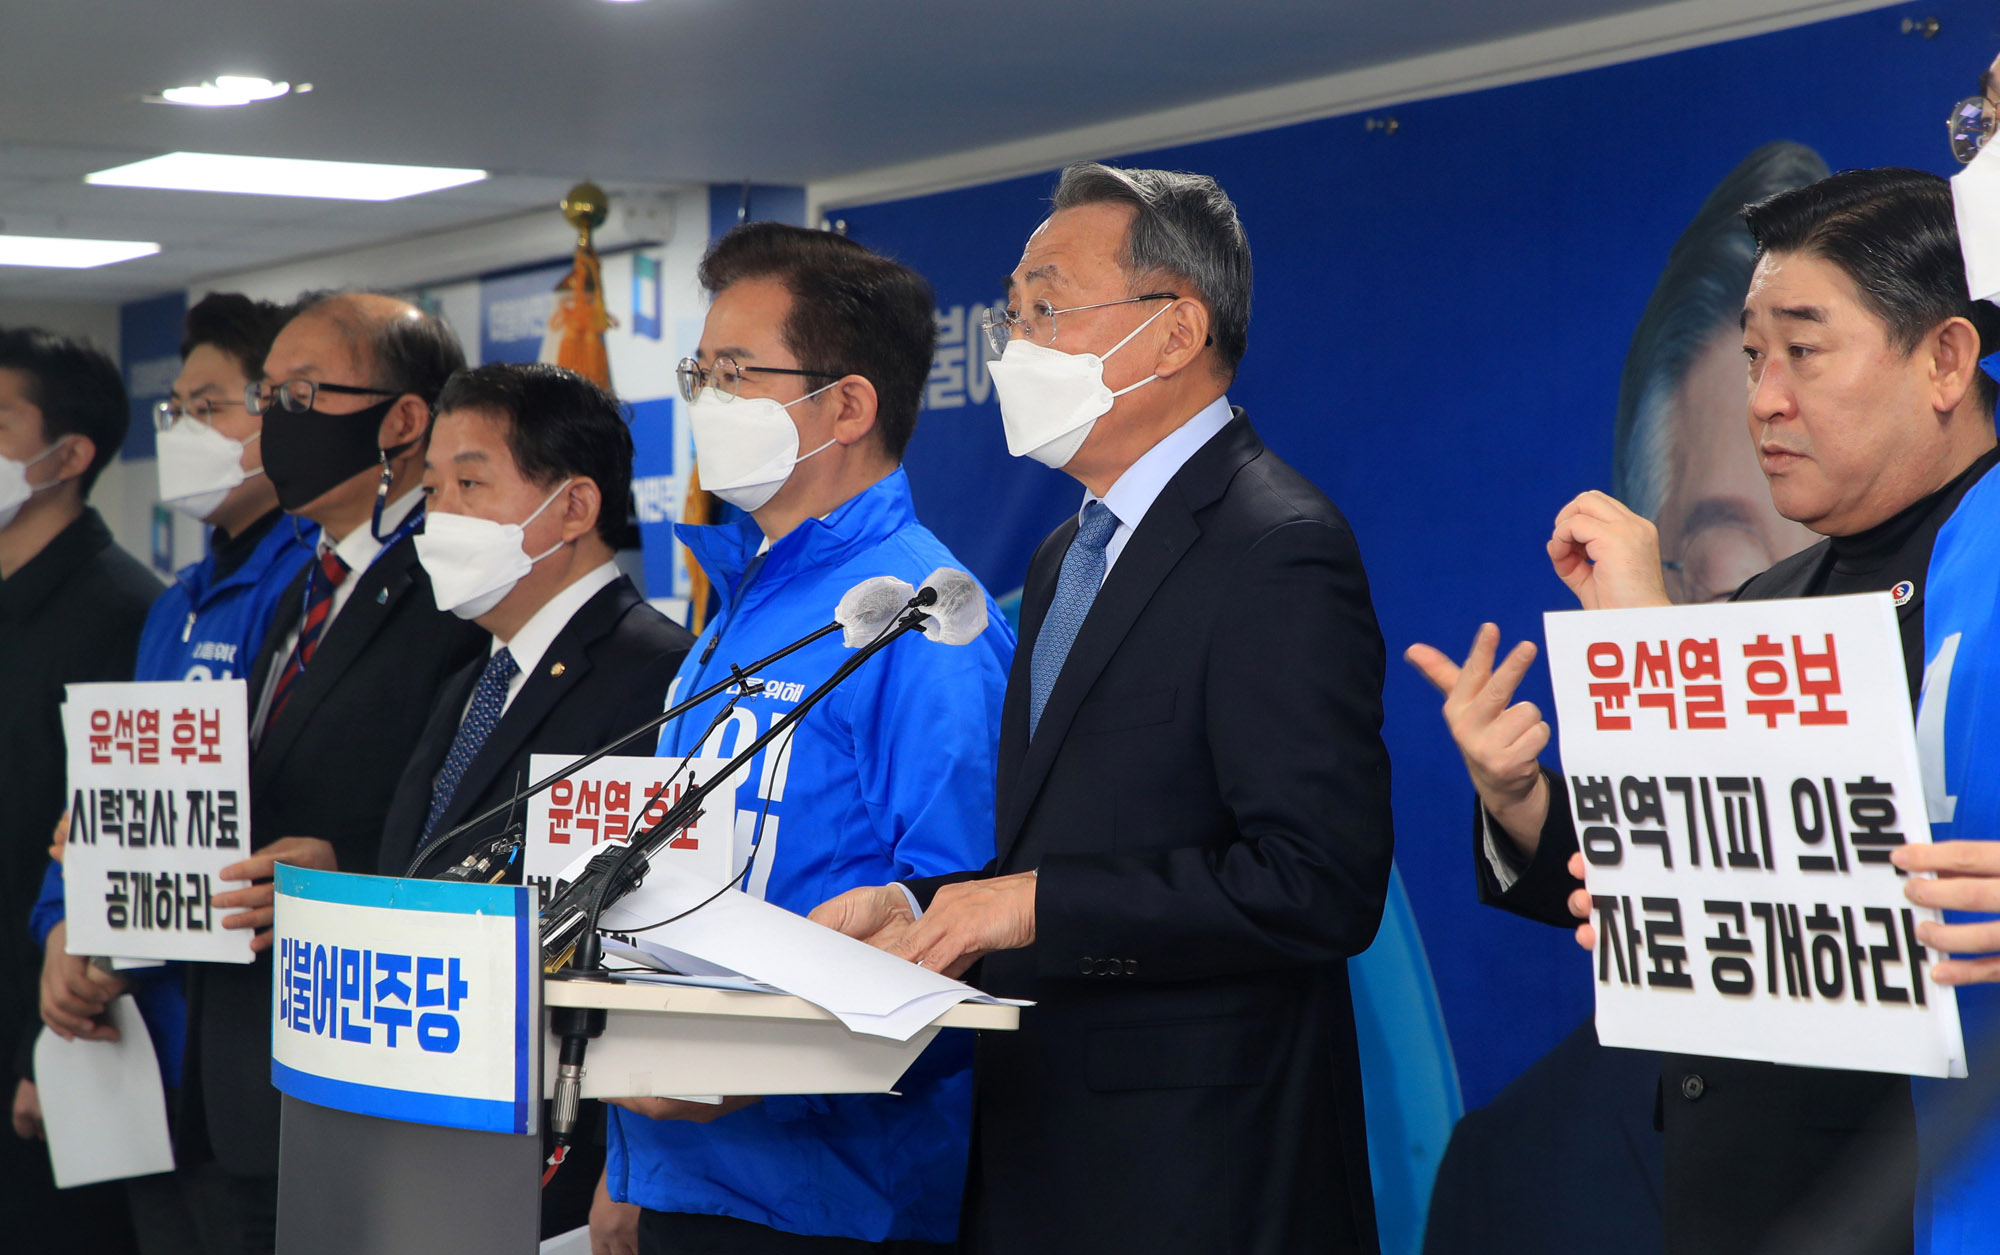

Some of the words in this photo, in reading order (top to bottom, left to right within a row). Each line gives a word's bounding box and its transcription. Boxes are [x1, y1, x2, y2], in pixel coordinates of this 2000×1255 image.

[1587, 637, 1727, 731] 윤석열
[1742, 632, 1849, 729] 후보
[90, 709, 160, 764] 윤석열
[171, 708, 222, 764] 후보
[68, 789, 178, 847] 시력검사
[186, 790, 240, 848] 자료
[548, 779, 631, 845] 윤석열
[1571, 775, 1774, 872] 병역기피
[1790, 776, 1908, 875] 의혹
[105, 871, 213, 931] 공개하라
[1591, 894, 1693, 989] 자료
[1703, 900, 1928, 1006] 공개하라
[281, 938, 468, 1054] 더불어민주당
